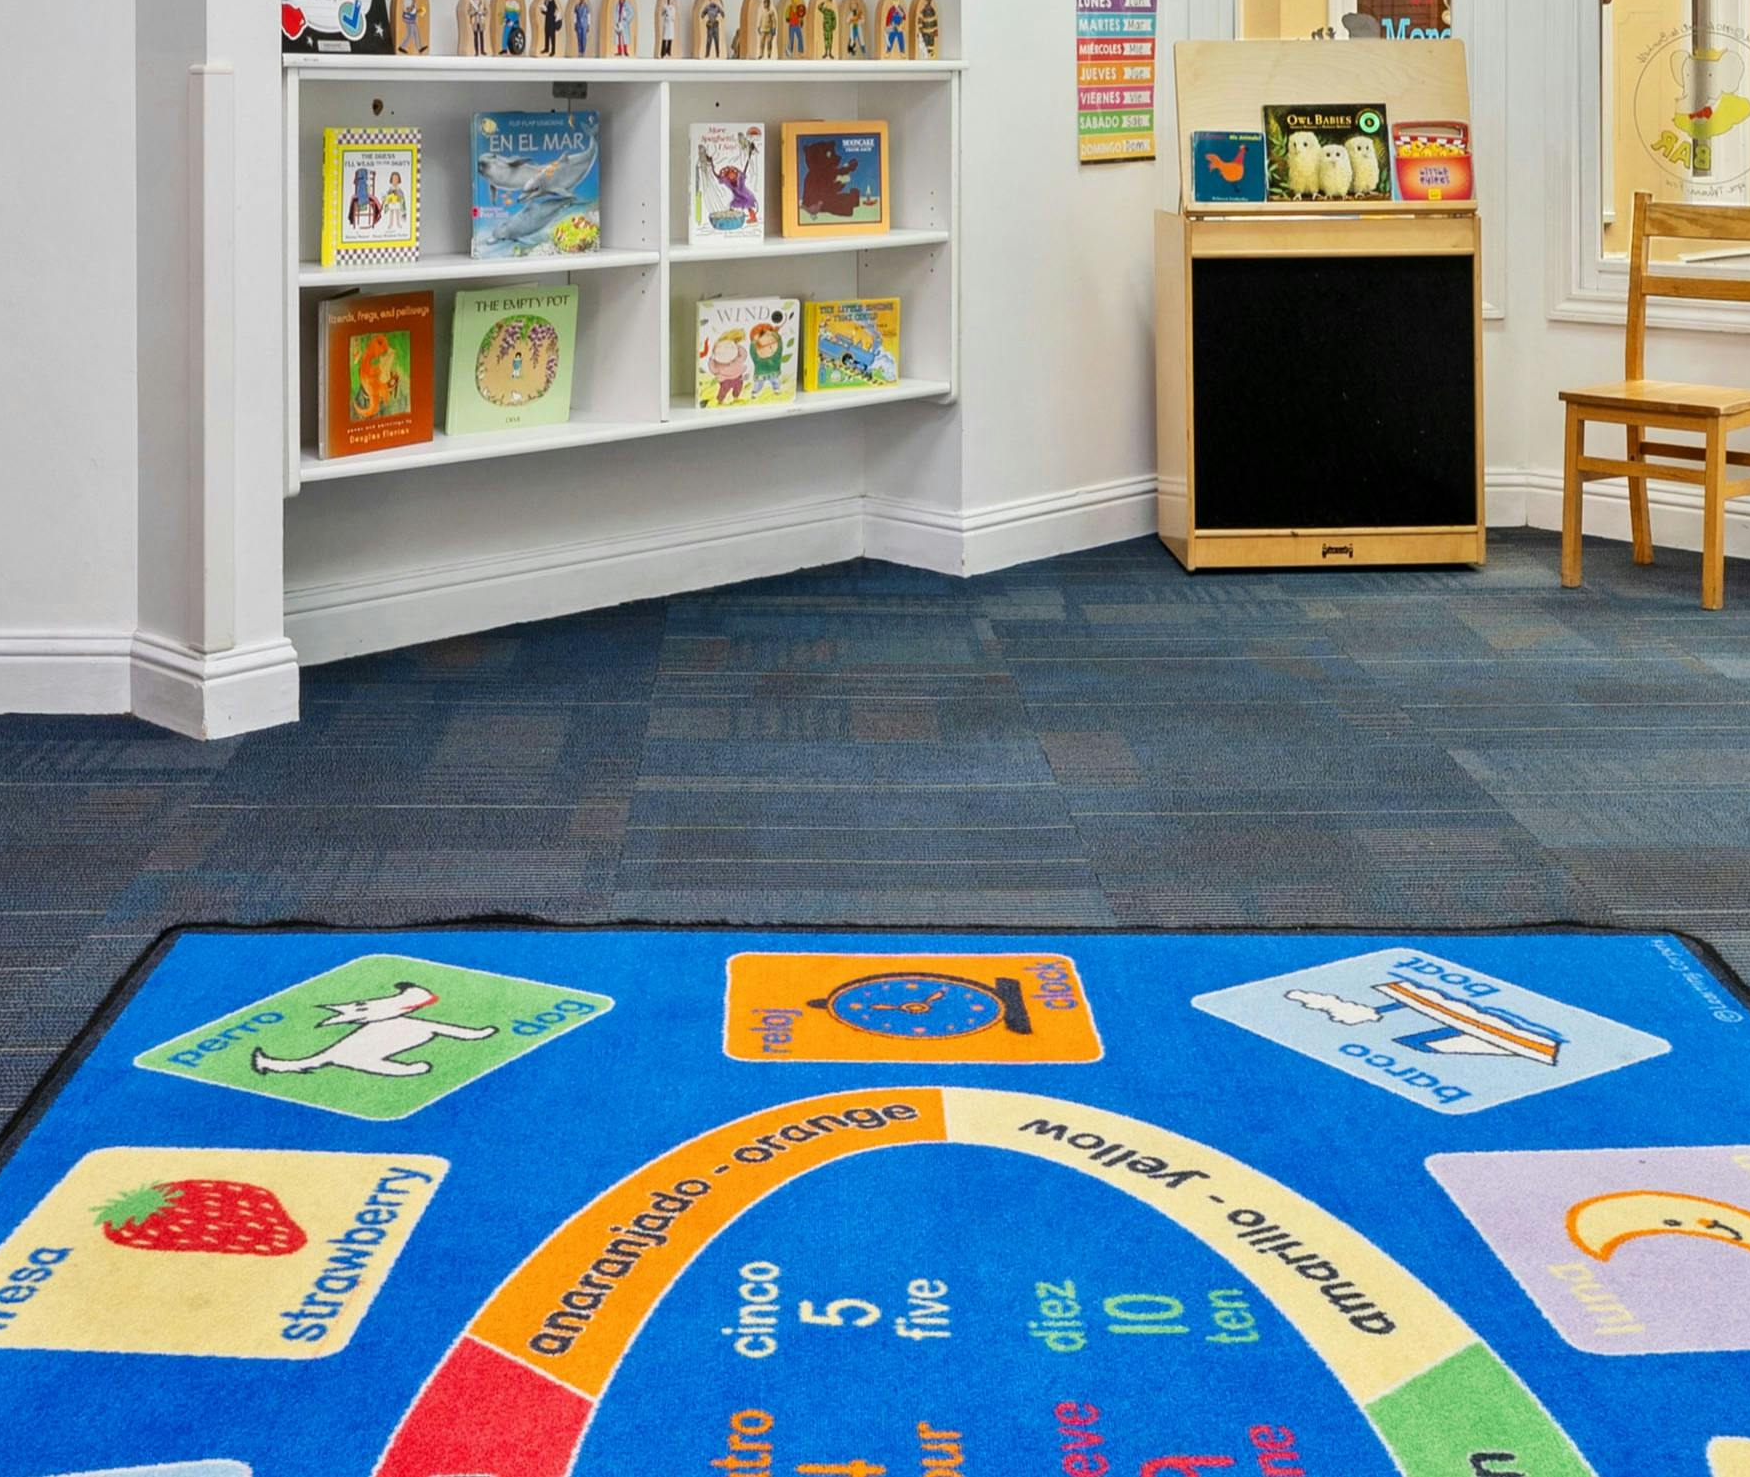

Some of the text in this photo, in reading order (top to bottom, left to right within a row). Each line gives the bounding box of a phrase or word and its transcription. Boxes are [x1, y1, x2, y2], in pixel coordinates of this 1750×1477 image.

[1078, 19, 1121, 32] MARTES
[1079, 41, 1123, 55] MIÉRCOLES
[1080, 67, 1117, 81] JUEVES
[1080, 91, 1121, 105] VIERNES
[1286, 113, 1352, 126] OWL BABIES
[489, 131, 585, 153] EN EL MAR
[1079, 114, 1120, 130] SÁBADO
[1081, 142, 1122, 156] DOMINGO
[380, 307, 395, 319] and
[475, 294, 571, 313] THE EMPTY POT
[1023, 959, 1078, 1010] clock
[1394, 954, 1501, 1000] boat
[167, 1009, 284, 1070] perro
[511, 997, 596, 1044] dog
[750, 1007, 801, 1054] reloj
[1344, 1040, 1473, 1105] barco
[527, 1100, 920, 1360] anaranjado orange
[1018, 1116, 1397, 1338] amarillo yellow
[280, 1165, 433, 1342] strawberry
[720, 1260, 781, 1358] cinco
[799, 1297, 882, 1329] 5
[896, 1277, 949, 1342] five
[1028, 1278, 1087, 1353] diez
[1103, 1294, 1190, 1334] 10
[1206, 1288, 1259, 1346] ten
[1547, 1261, 1645, 1336] luna
